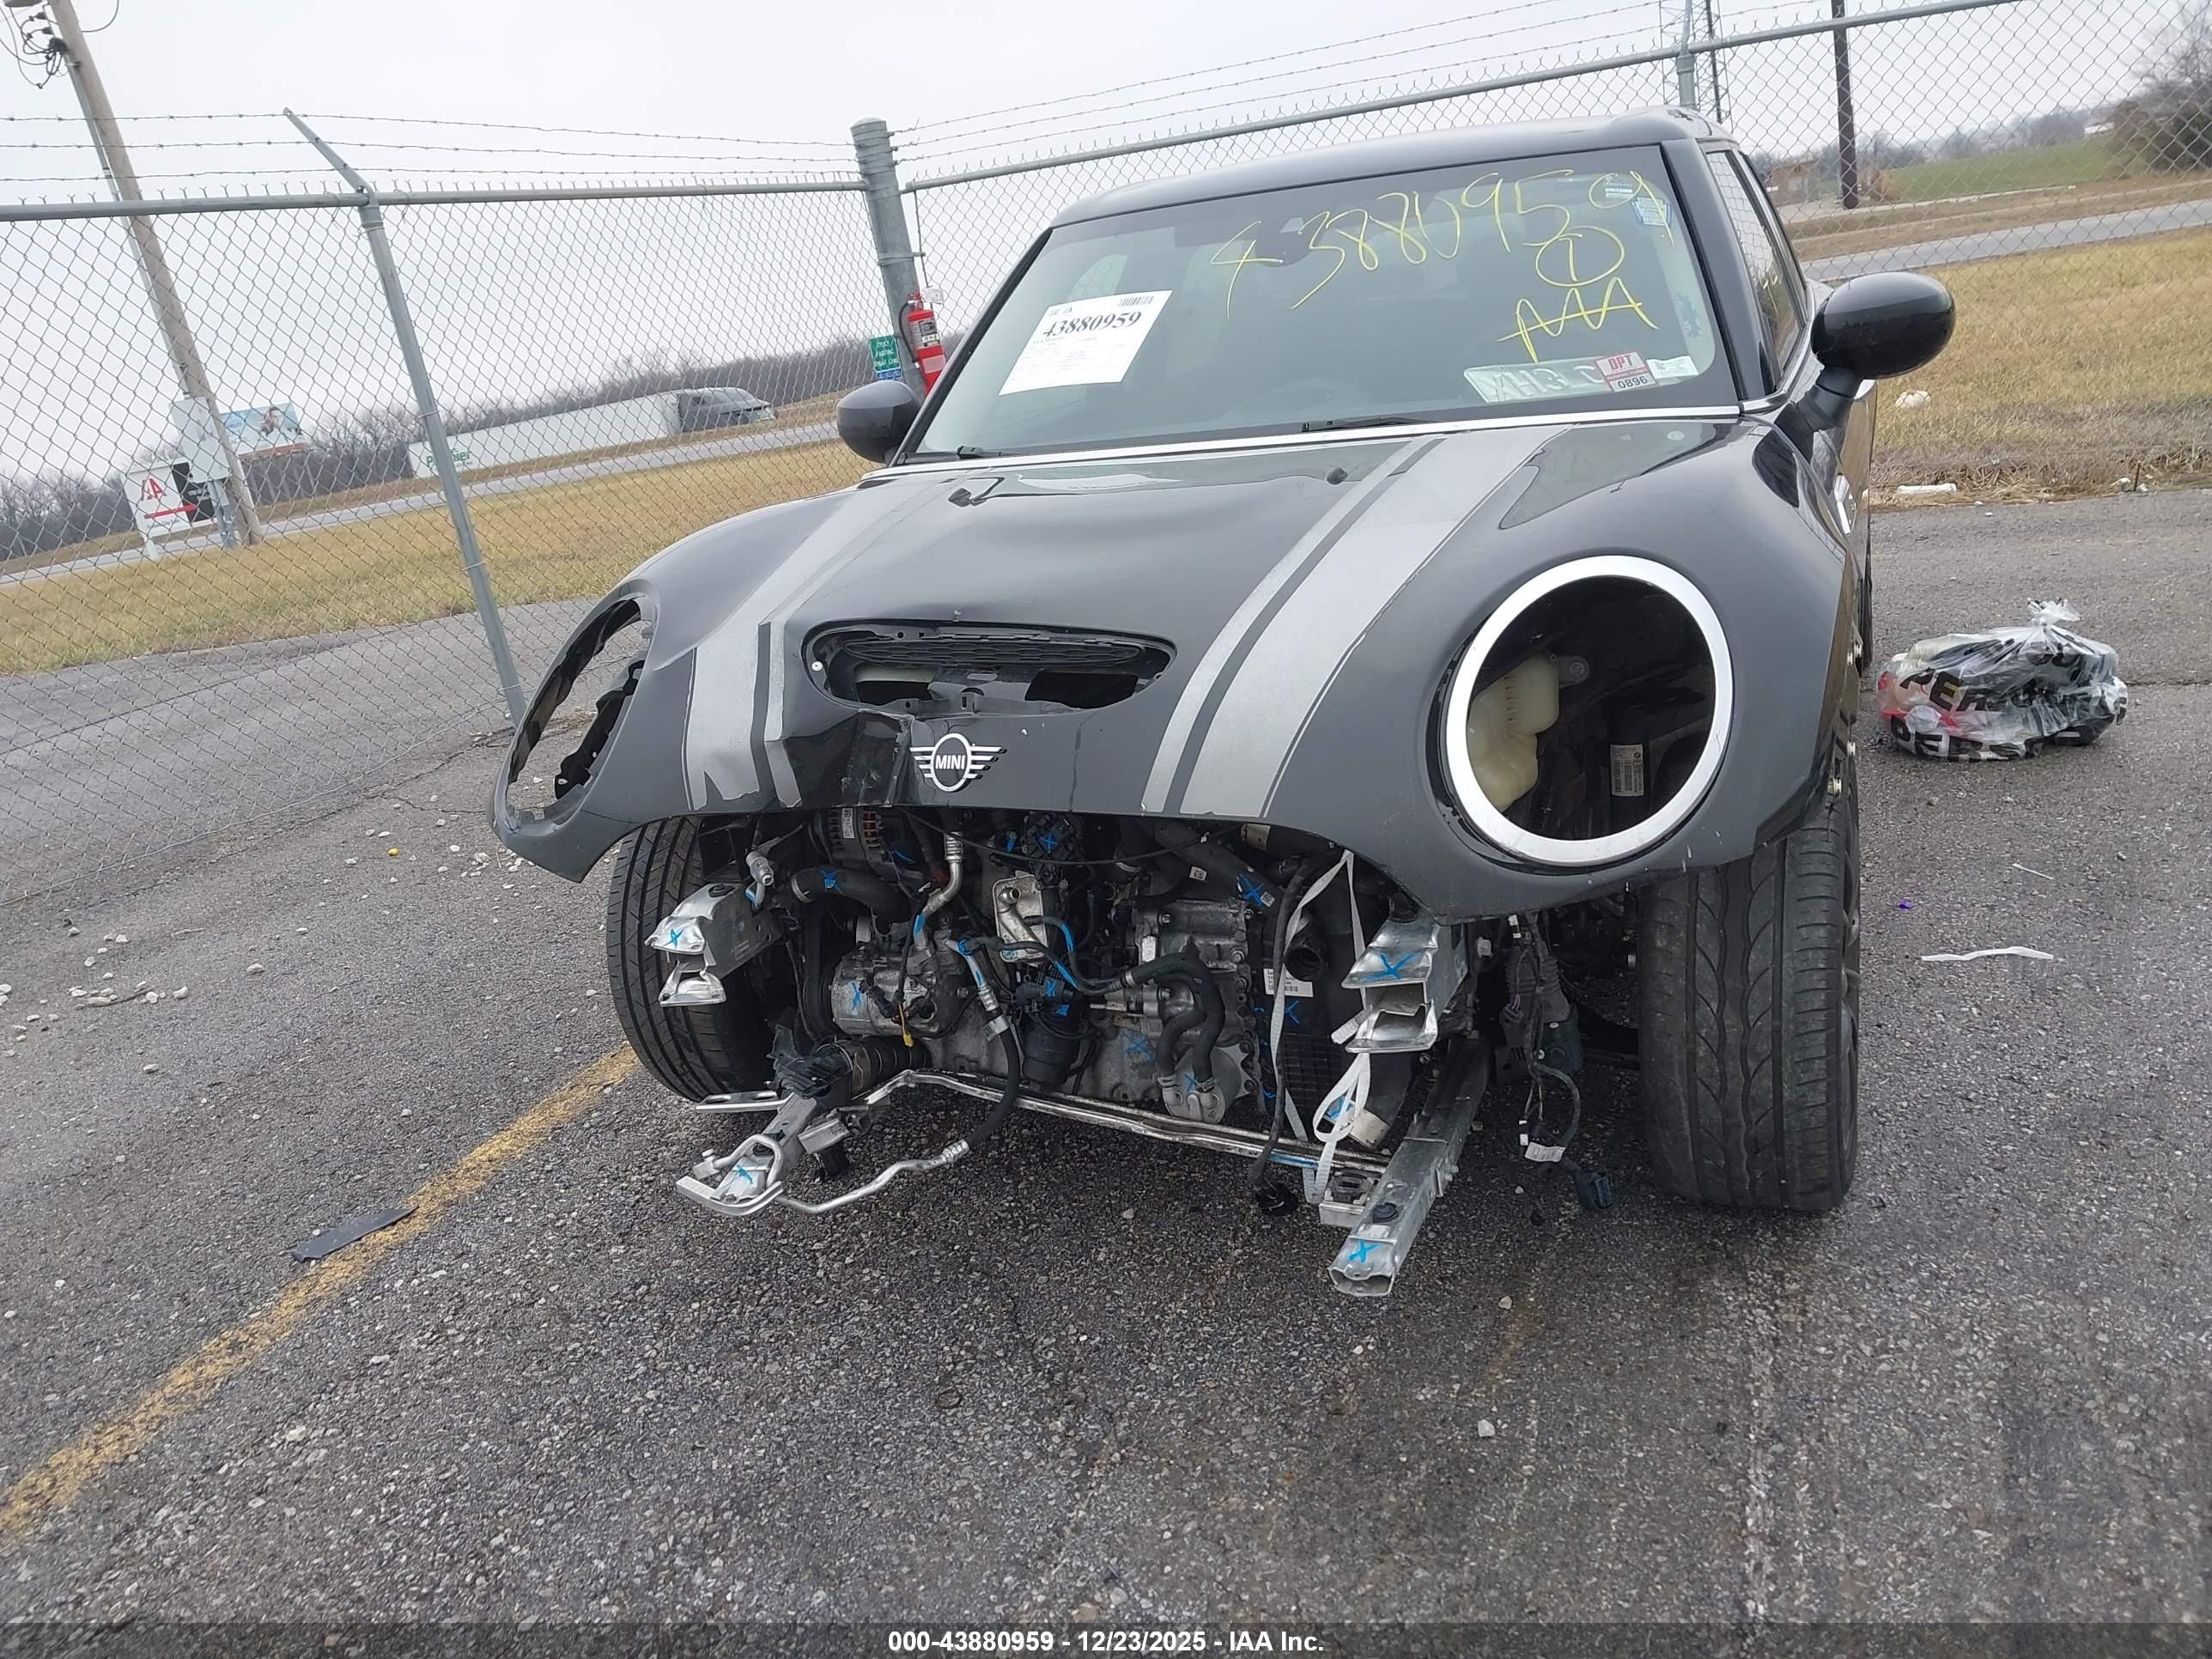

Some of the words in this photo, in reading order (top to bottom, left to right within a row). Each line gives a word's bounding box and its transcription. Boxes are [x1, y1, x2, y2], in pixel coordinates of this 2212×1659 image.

[1042, 311, 1142, 337] 43880959
[1607, 354, 1634, 371] DPT
[1617, 375, 1649, 389] 0896
[934, 754, 966, 770] MINI
